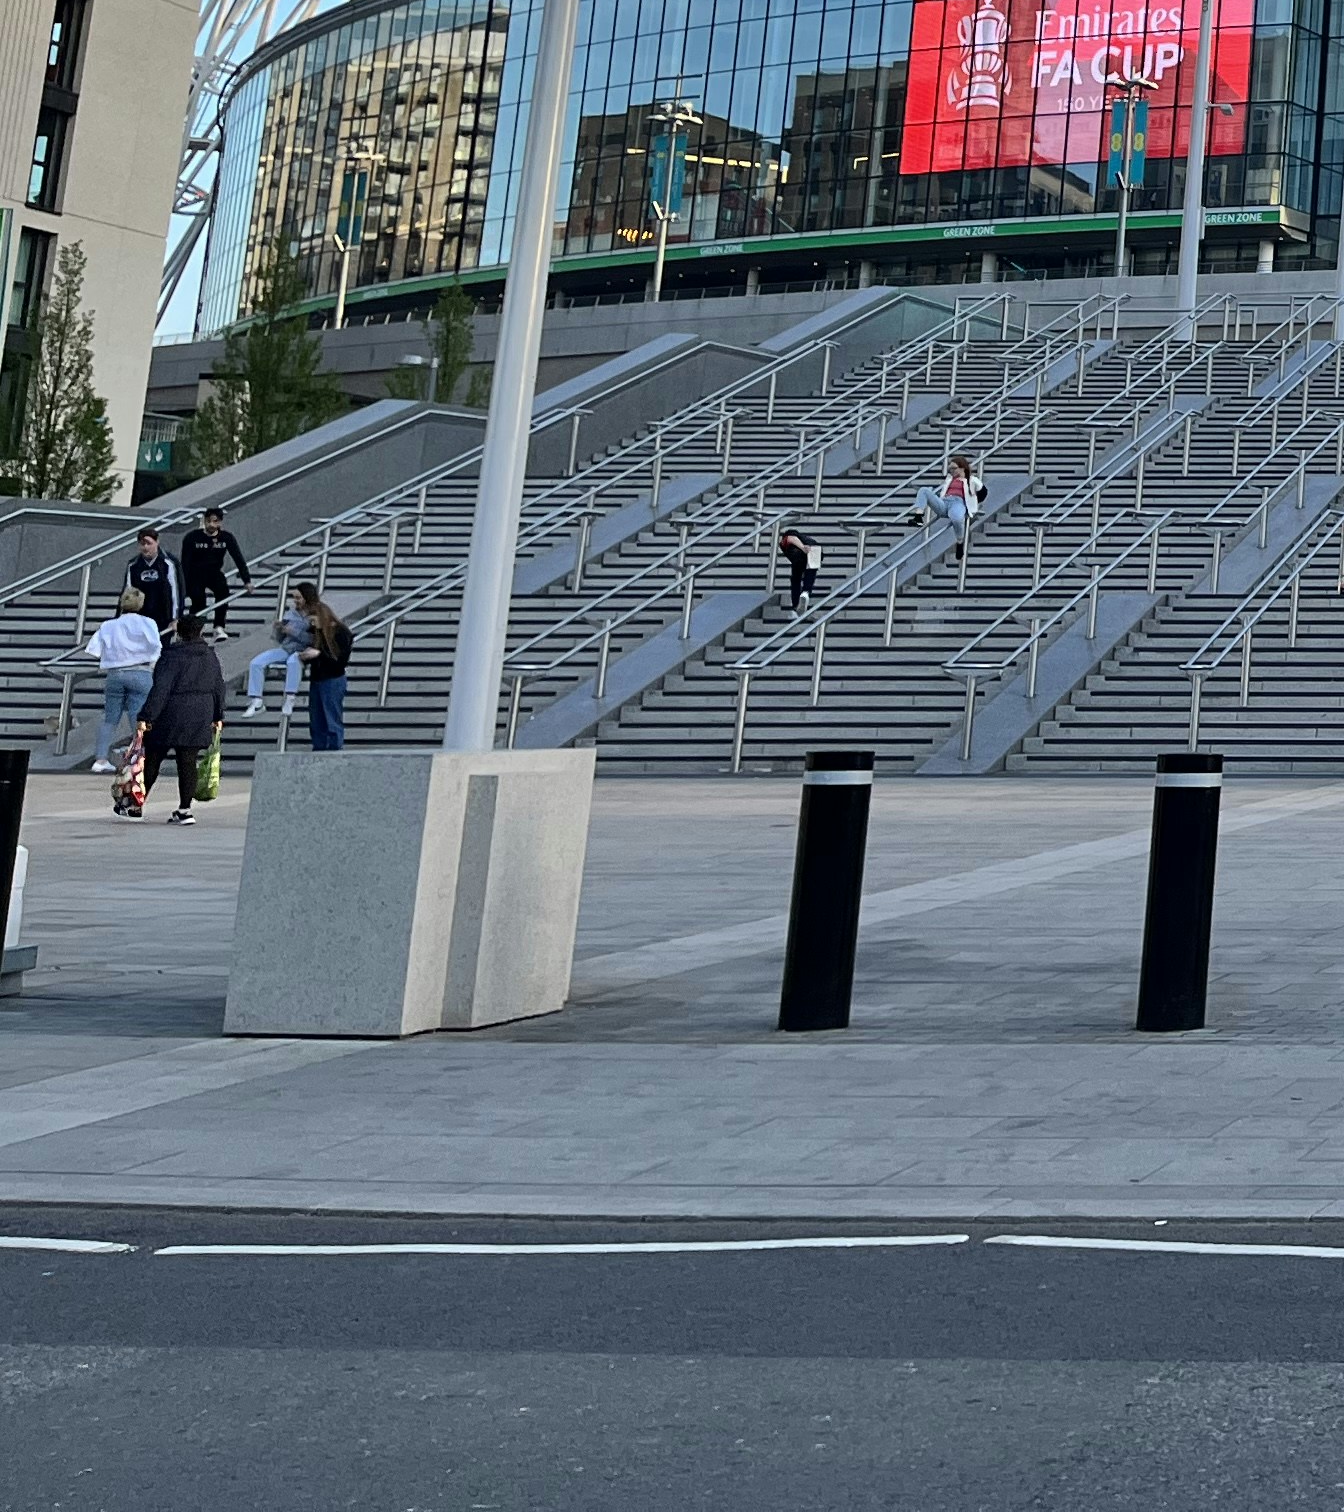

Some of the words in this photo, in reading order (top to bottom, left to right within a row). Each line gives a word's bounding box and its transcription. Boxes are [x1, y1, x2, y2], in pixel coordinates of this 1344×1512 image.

[1034, 5, 1185, 45] Emirates
[1031, 49, 1083, 88] FA
[1090, 42, 1185, 86] CUP
[1204, 213, 1235, 224] GREEN
[1236, 212, 1263, 223] ZONE
[943, 227, 971, 238] GREEN
[972, 225, 995, 236] ZONE
